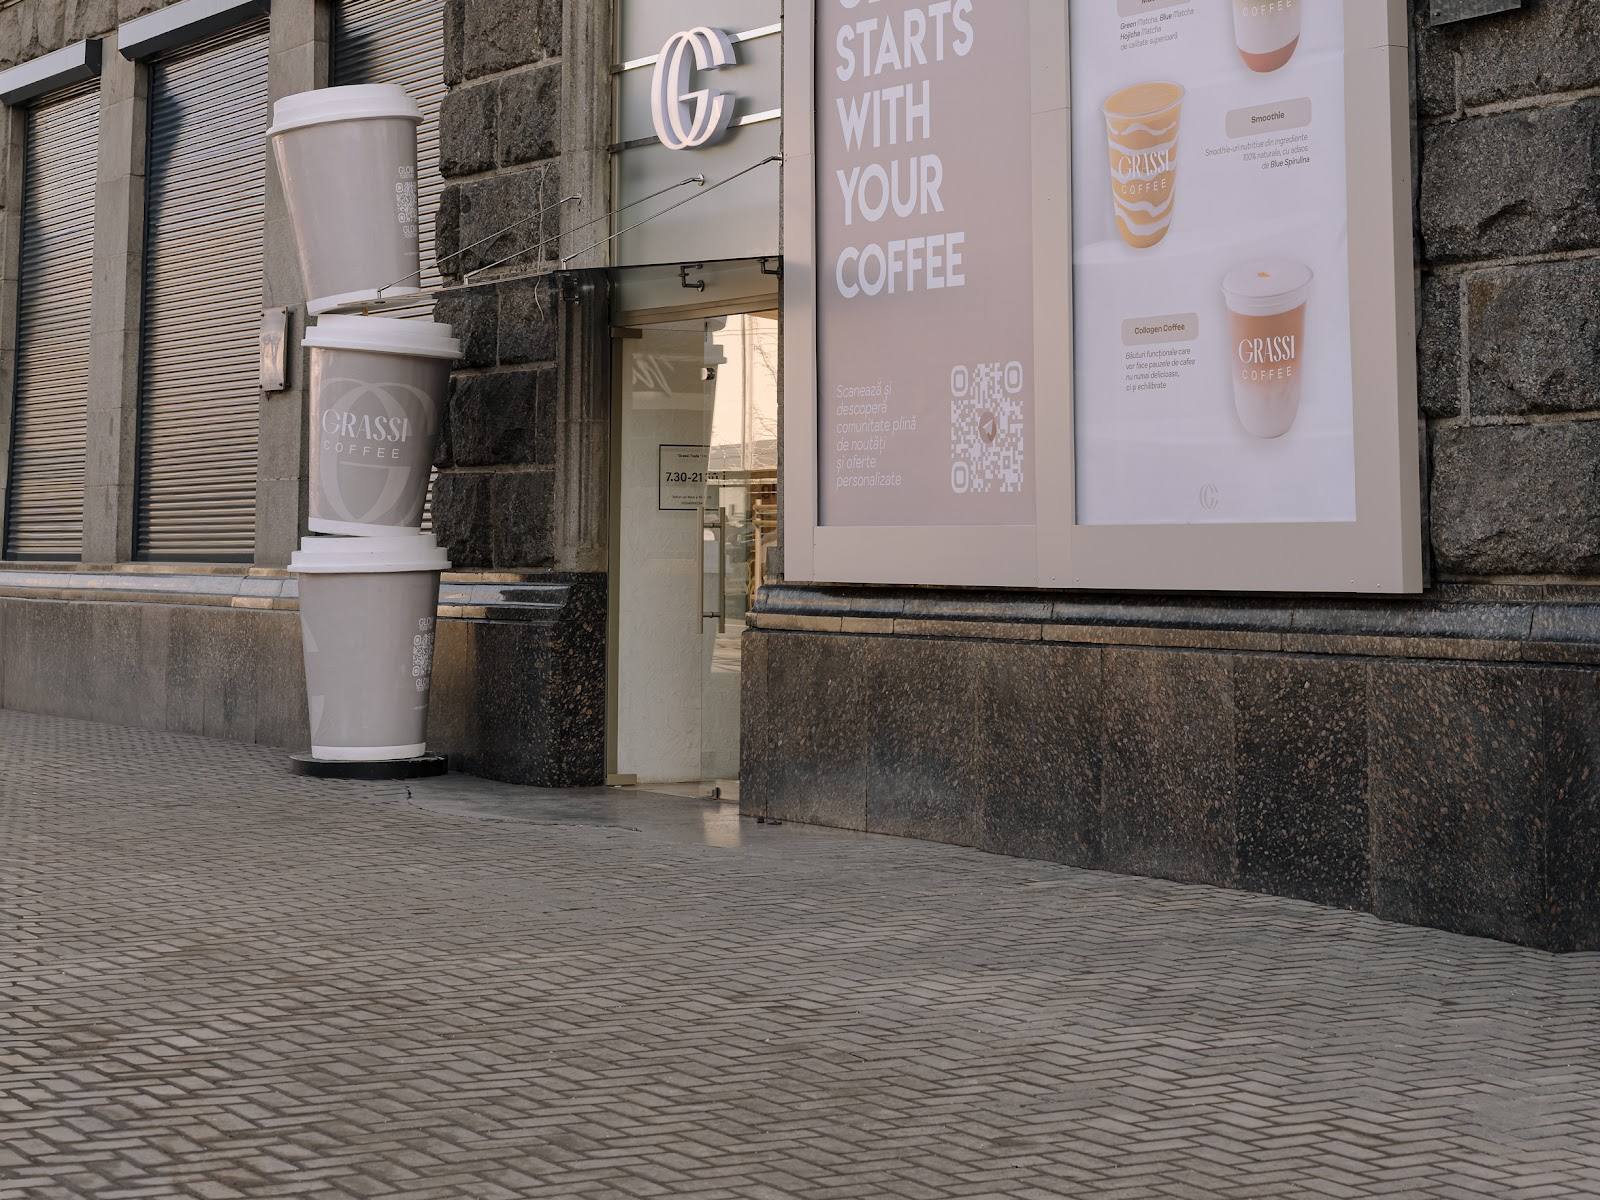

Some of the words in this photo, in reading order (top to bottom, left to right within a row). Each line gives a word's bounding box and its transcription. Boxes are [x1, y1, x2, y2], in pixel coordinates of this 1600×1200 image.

[836, 79, 930, 152] WITH
[1251, 111, 1284, 123] Smoothie
[1119, 149, 1168, 177] GRASSI
[1271, 160, 1283, 168] Blue
[1285, 155, 1310, 166] Spirulina
[836, 154, 944, 225] YOUR
[1122, 179, 1166, 194] COFFEE
[836, 232, 966, 299] COFFEE
[1135, 326, 1162, 334] Collagen
[1163, 324, 1185, 332] Coffee
[1239, 336, 1294, 363] GRASSI
[1242, 366, 1291, 380] COFFEE
[323, 409, 408, 442] GRASSI
[324, 440, 400, 458] COFFEE
